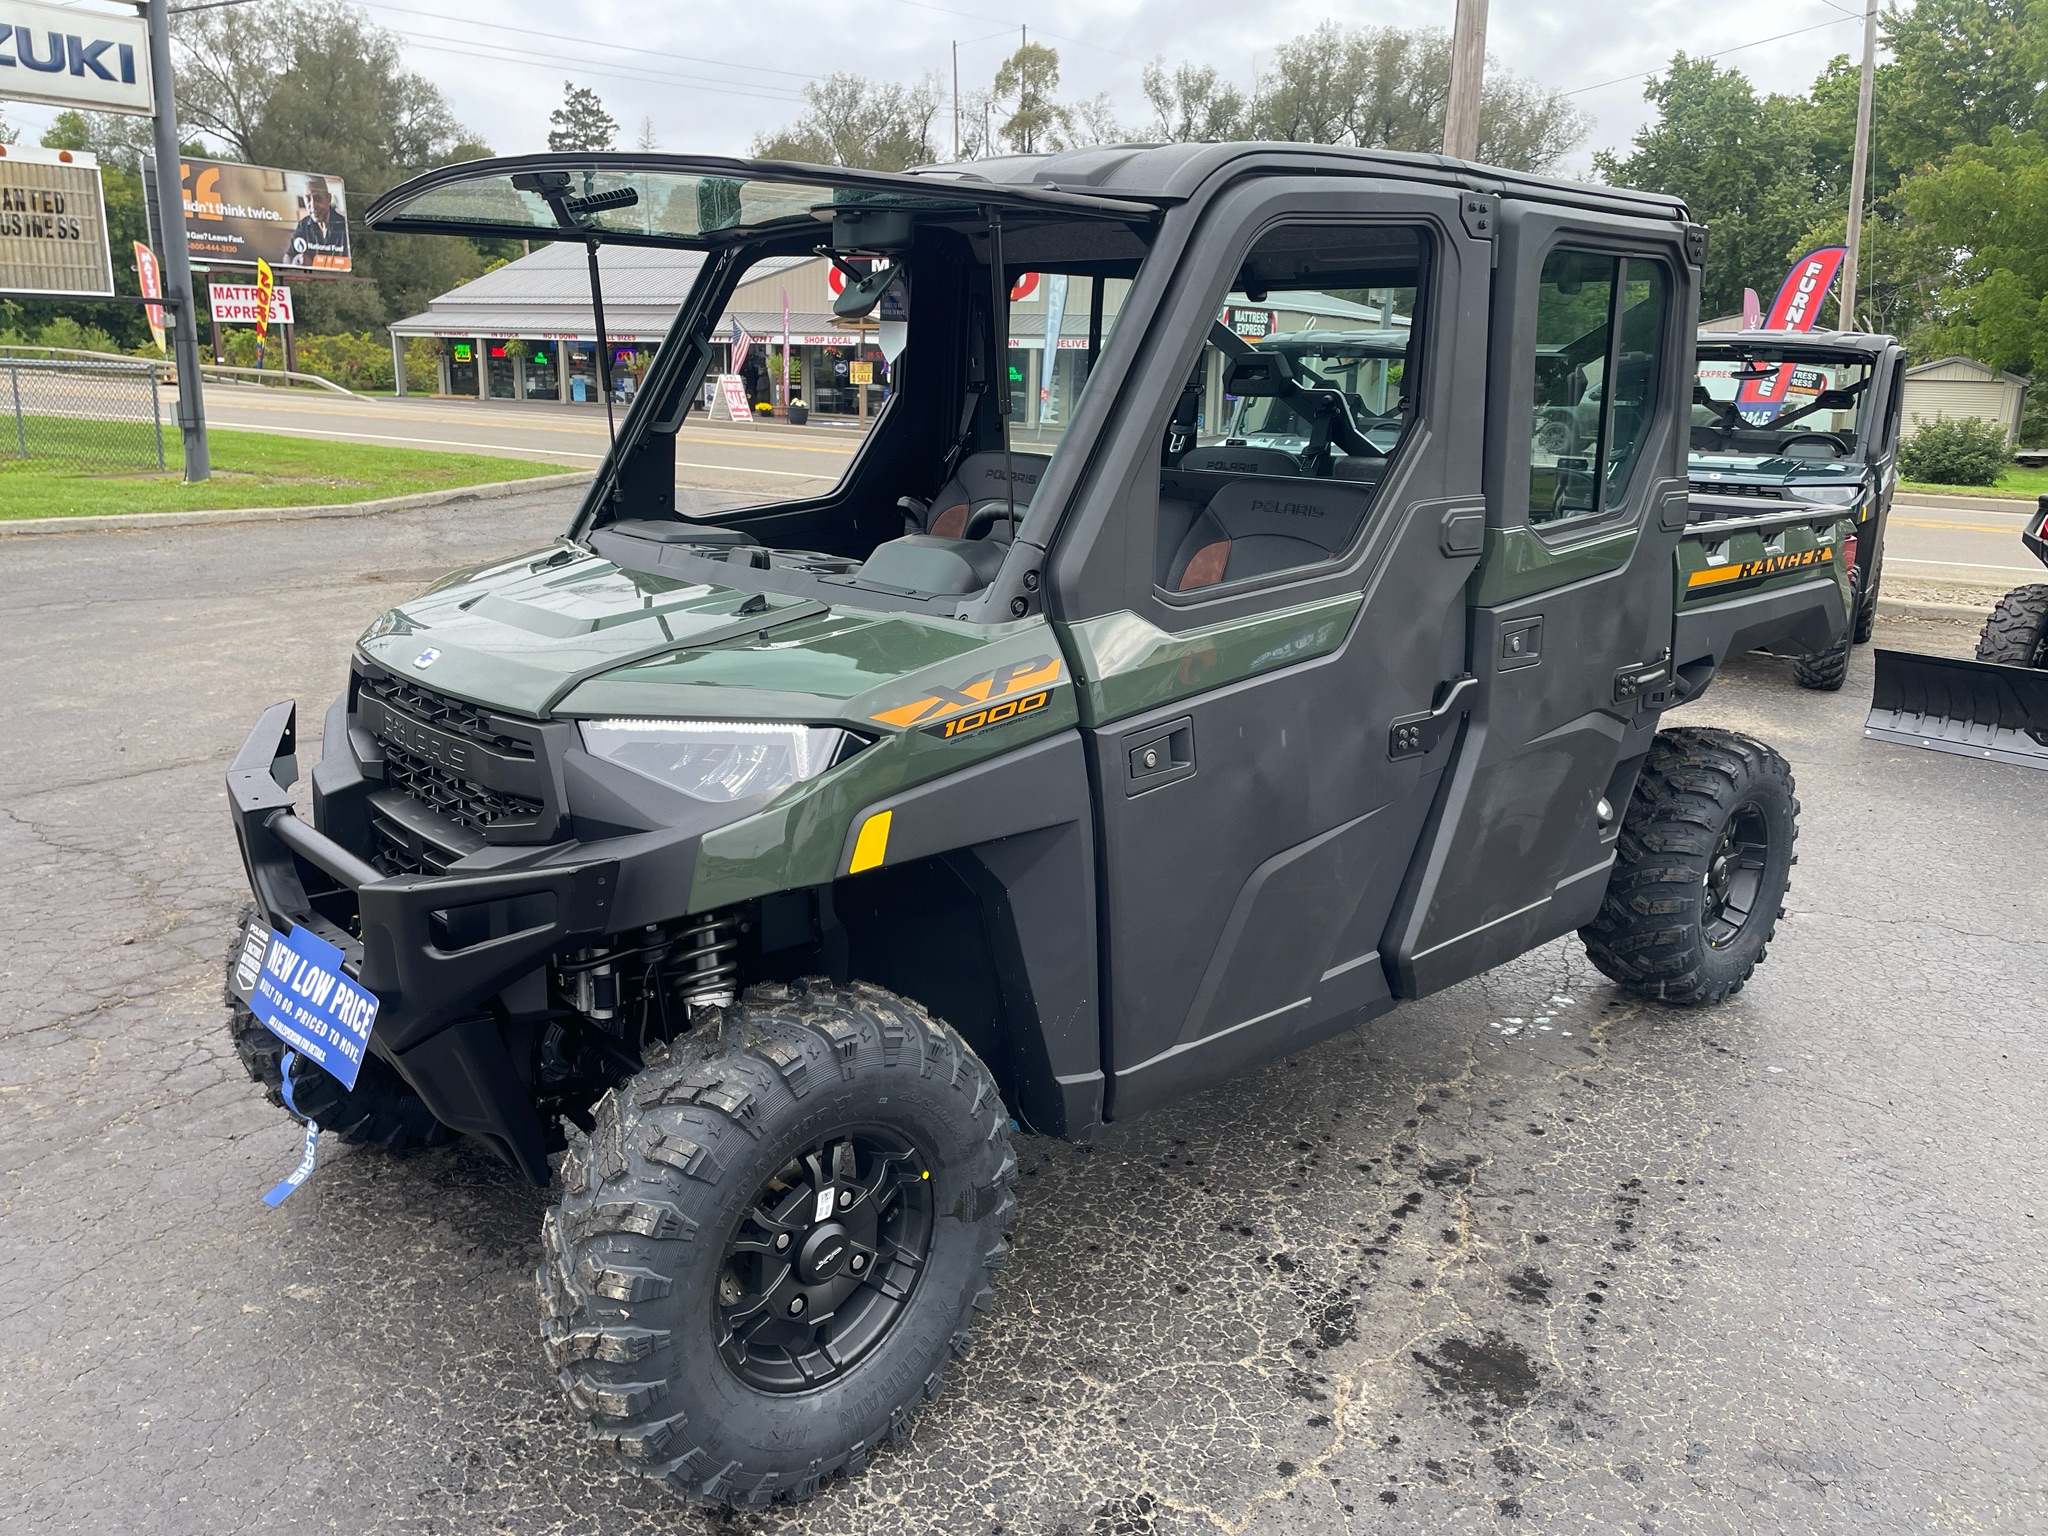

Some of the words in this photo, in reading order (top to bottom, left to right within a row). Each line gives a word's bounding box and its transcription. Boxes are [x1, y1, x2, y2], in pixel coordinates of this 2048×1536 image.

[3, 187, 65, 215] ANTED
[215, 203, 247, 218] think
[247, 205, 283, 221] twice.
[0, 212, 80, 241] USINESS
[213, 286, 285, 302] MATTRSS
[215, 304, 277, 320] EXPRES
[1234, 310, 1269, 324] MATTRESS
[1236, 323, 1266, 336] EXPRESS
[804, 336, 825, 344] SHOP
[827, 337, 852, 345] LOCAL
[1207, 460, 1258, 474] POLARIS
[985, 468, 1038, 485] POLARIS
[1251, 499, 1325, 518] POLARIS
[1738, 548, 1826, 579] RANGER
[944, 691, 1048, 738] 1000
[383, 711, 466, 772] POLARIS
[267, 939, 300, 984] NEW
[291, 959, 337, 1007] LOW
[328, 982, 375, 1040] PRICE
[259, 978, 276, 997] BUILT
[273, 988, 284, 1007] TO
[294, 1007, 329, 1038] PRICED
[328, 1028, 340, 1047] TO
[339, 1036, 360, 1064] MOVE.
